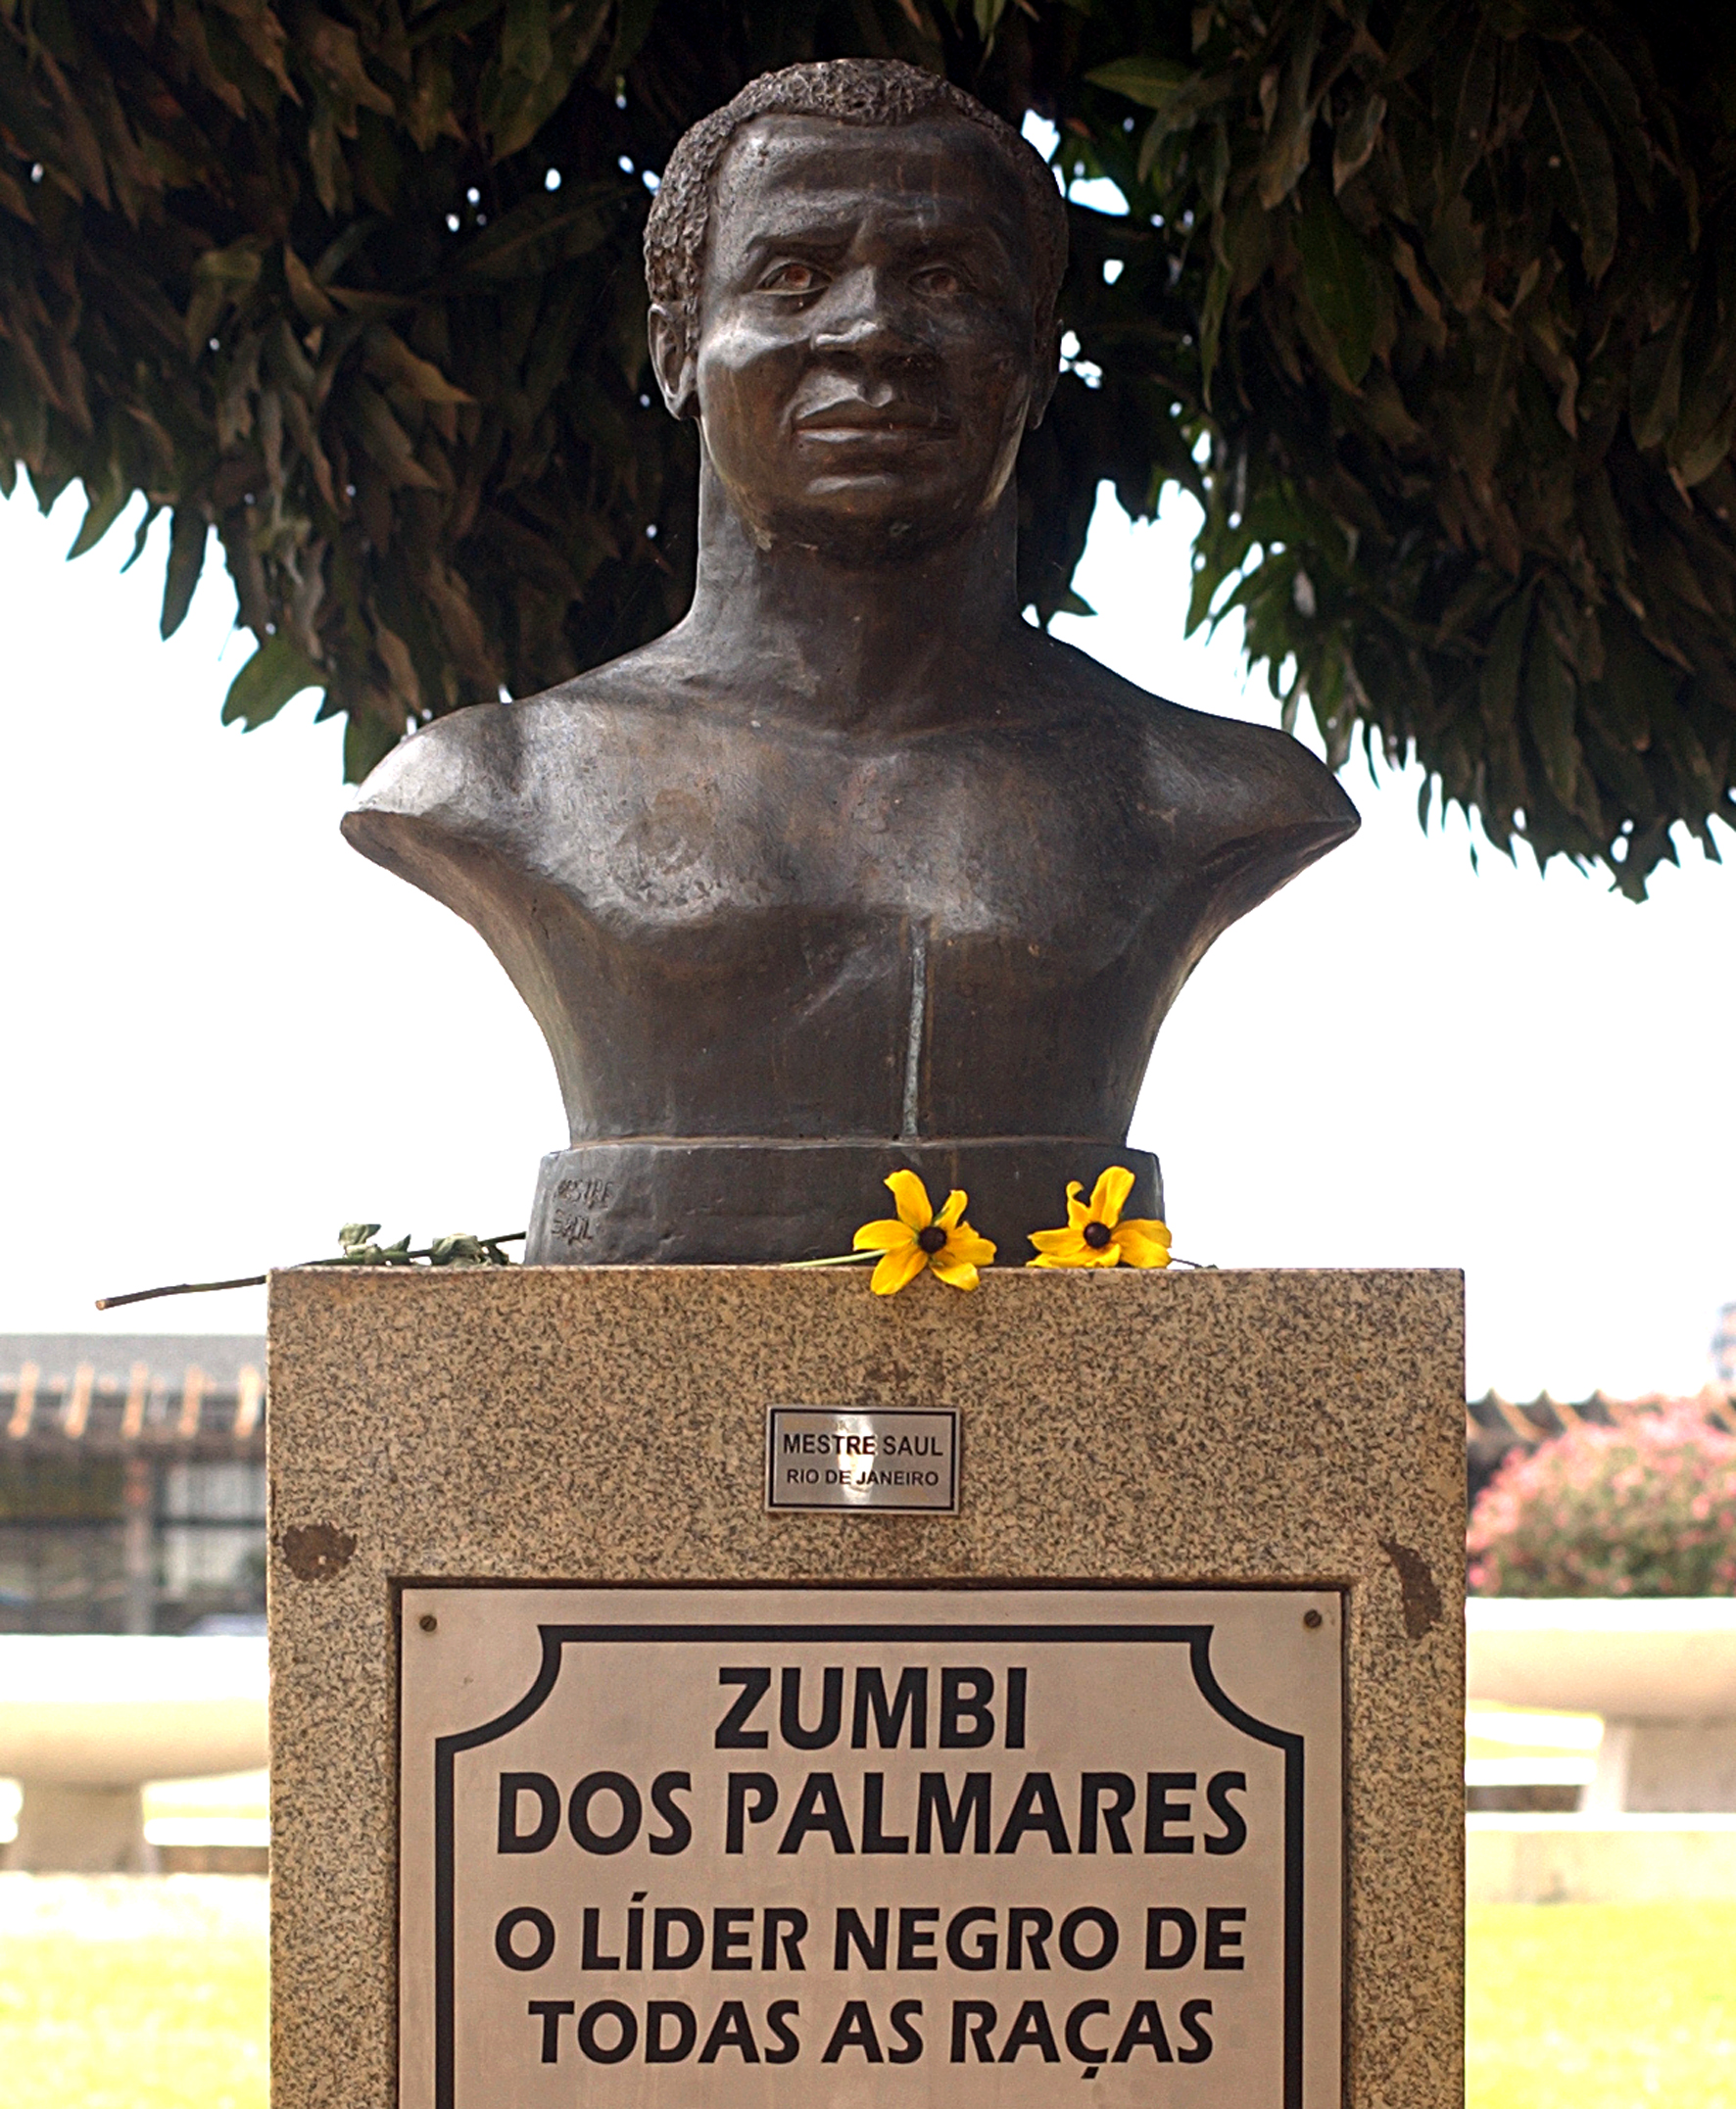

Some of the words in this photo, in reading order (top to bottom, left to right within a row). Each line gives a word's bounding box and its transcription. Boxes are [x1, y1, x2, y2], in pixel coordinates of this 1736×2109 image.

[783, 1434, 876, 1456] MESTRE
[883, 1435, 943, 1457] SAUL
[787, 1468, 819, 1484] RIO
[826, 1469, 851, 1485] DE
[856, 1469, 939, 1486] JANEIRO
[714, 1666, 1028, 1750] ZUMBI
[497, 1770, 693, 1855] DOS
[725, 1770, 1247, 1855] PALMARES
[495, 1906, 555, 1971] O
[581, 1891, 808, 1971] LÍDER
[833, 1905, 1120, 1971] NEGRO
[1144, 1906, 1246, 1971] DE
[527, 1999, 800, 2064] TODAS
[820, 1998, 924, 2064] AS
[949, 1998, 1214, 2080] RAÇAS
